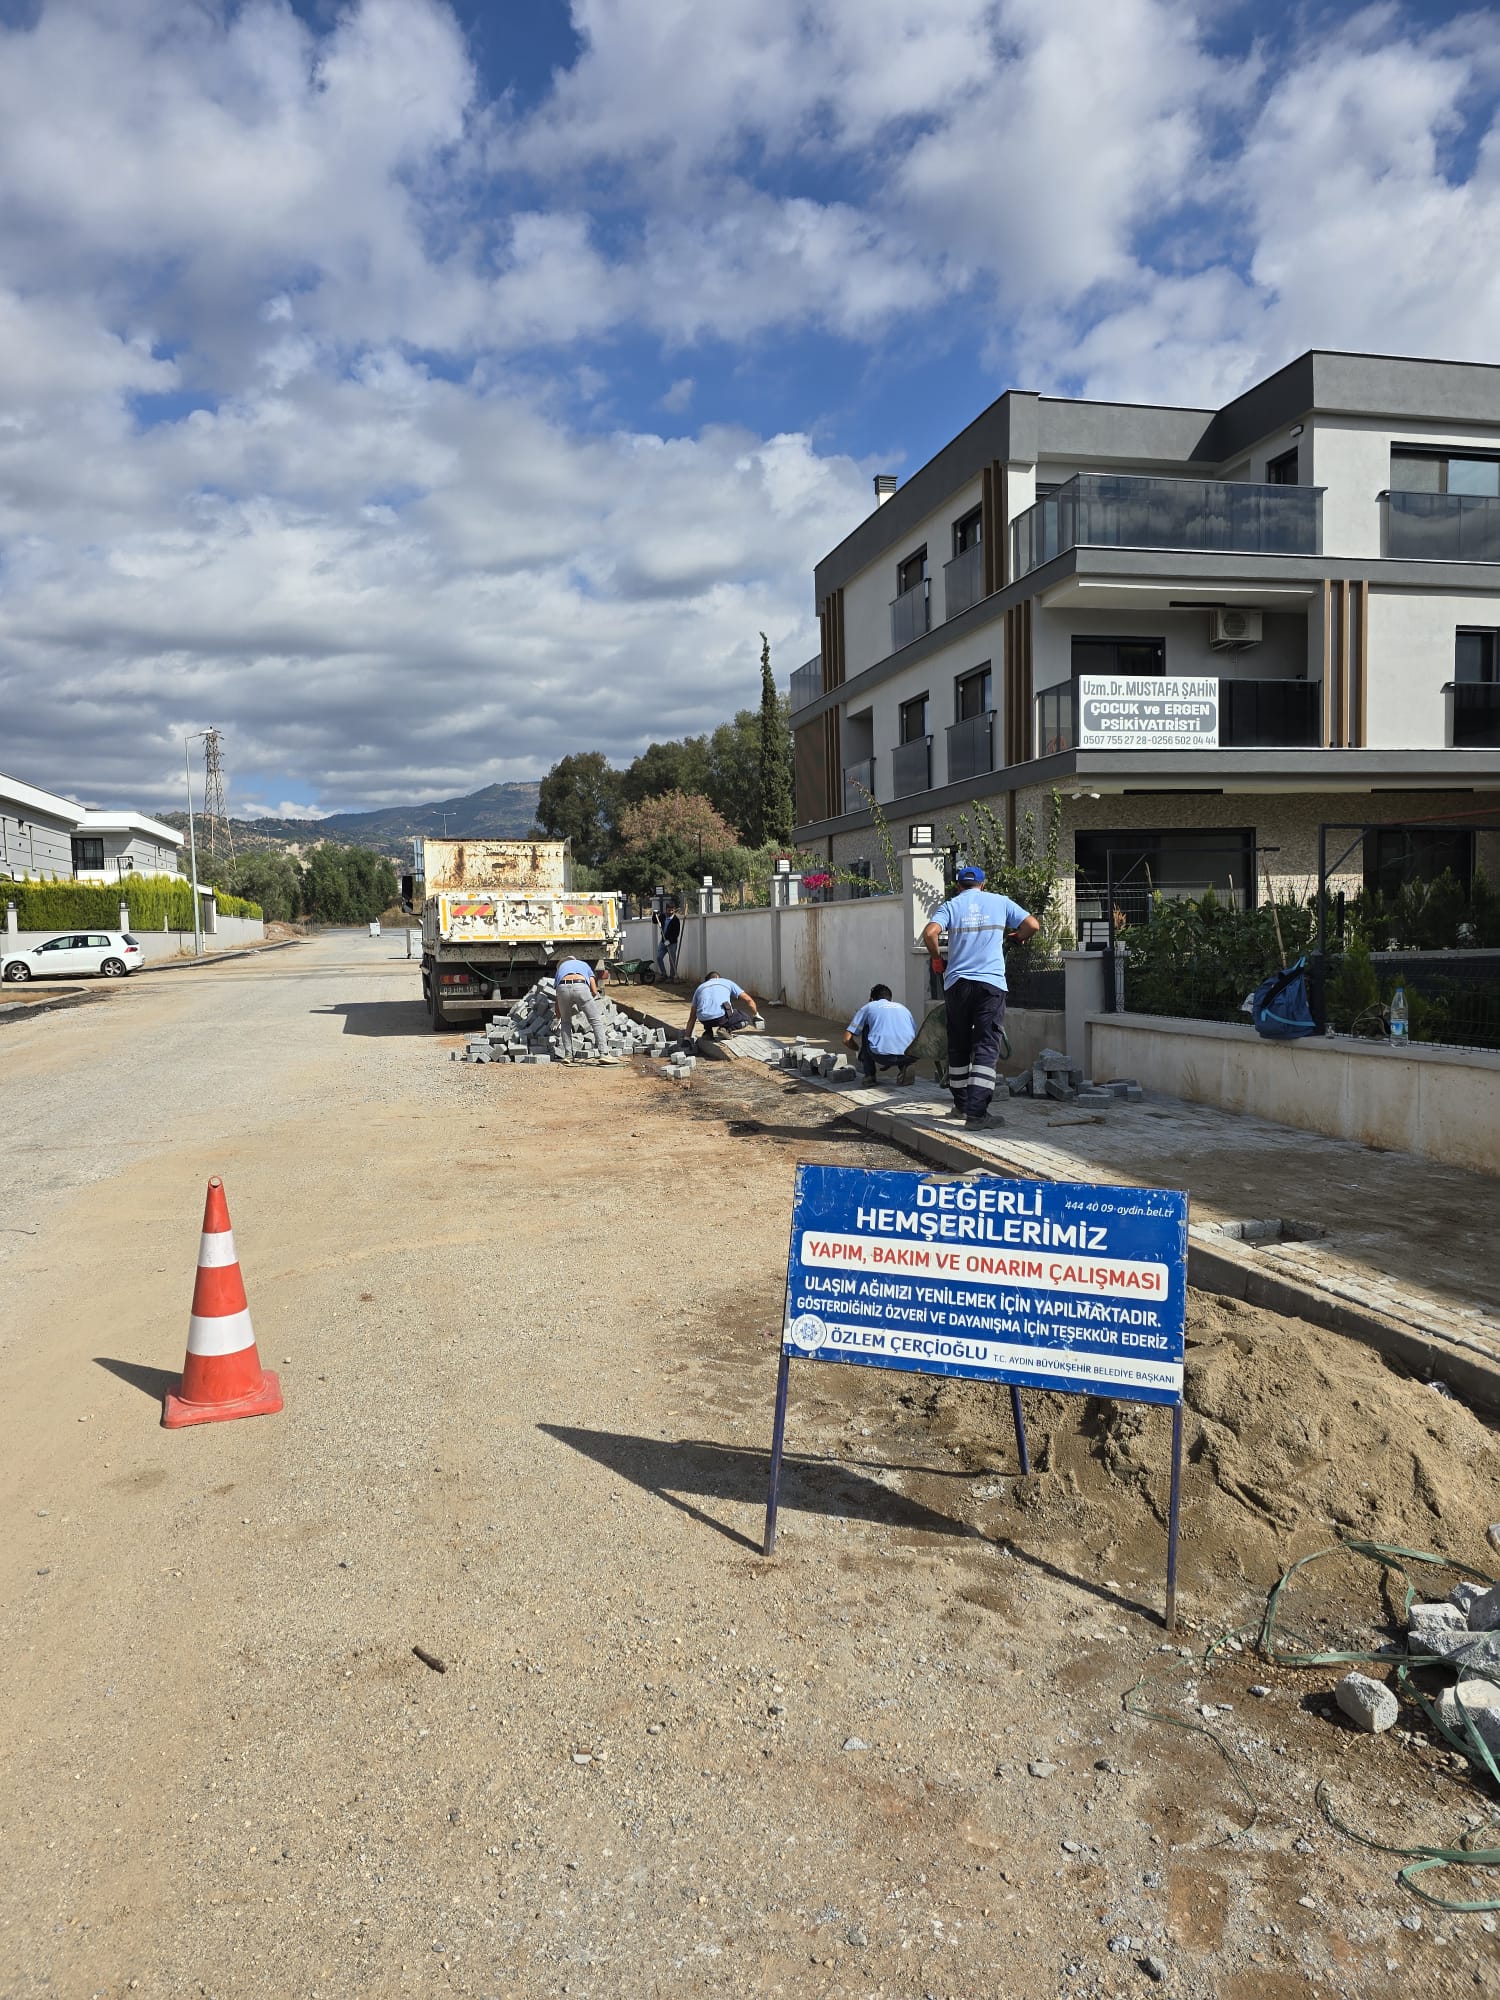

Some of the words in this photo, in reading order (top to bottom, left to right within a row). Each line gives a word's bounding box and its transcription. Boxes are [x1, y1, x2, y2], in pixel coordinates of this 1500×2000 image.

[1181, 680, 1216, 700] ŞAHİN
[1090, 702, 1139, 716] ÇOCUK
[1143, 705, 1160, 715] ve
[1164, 703, 1210, 716] ERGEN
[1101, 716, 1200, 731] PSİKİYATRİSTİ
[1083, 735, 1105, 745] 0507
[1107, 735, 1123, 745] 755
[1124, 735, 1134, 745] 27
[1174, 735, 1191, 745] 502
[1192, 736, 1204, 745] 04
[1205, 736, 1216, 745] 44
[916, 1182, 1043, 1217] DEĞERLİ
[1064, 1200, 1084, 1211] 444
[1085, 1202, 1099, 1212] 40
[856, 1207, 1108, 1250] HEMŞERİLERİMİZ
[809, 1240, 867, 1264] YAPIM,
[872, 1246, 930, 1267] BAKIM
[935, 1252, 960, 1271] VE
[966, 1256, 1043, 1279] ONARIM
[1049, 1263, 1161, 1291] ÇALIŞMASI
[804, 1275, 856, 1297] ULAŞIM
[859, 1278, 912, 1301] AĞIMIZI
[915, 1286, 997, 1310] YENİLEMEK
[1000, 1292, 1031, 1316] İÇİN
[1034, 1299, 1161, 1328] YAPILMAKTADIR.
[796, 1296, 882, 1318] GÖSTERDİĞİNİZ
[885, 1303, 927, 1323] ÖZVERİ
[930, 1311, 946, 1325] VE
[949, 1313, 1021, 1333] DAYANIŞMA
[1024, 1318, 1049, 1338] İÇİN
[1051, 1324, 1118, 1344] TEŞEKKÜR
[1121, 1332, 1168, 1350] EDERİZ
[831, 1327, 886, 1348] ÖZLEM
[890, 1336, 987, 1360] ÇERÇİOĞLU
[993, 1354, 1007, 1364] T.C.
[1009, 1356, 1034, 1367] AYDIN
[1036, 1358, 1092, 1374] BÜYÜKŞEHİR
[1093, 1366, 1134, 1379] BELEDİYE
[1135, 1372, 1175, 1384] BAŞKANI
